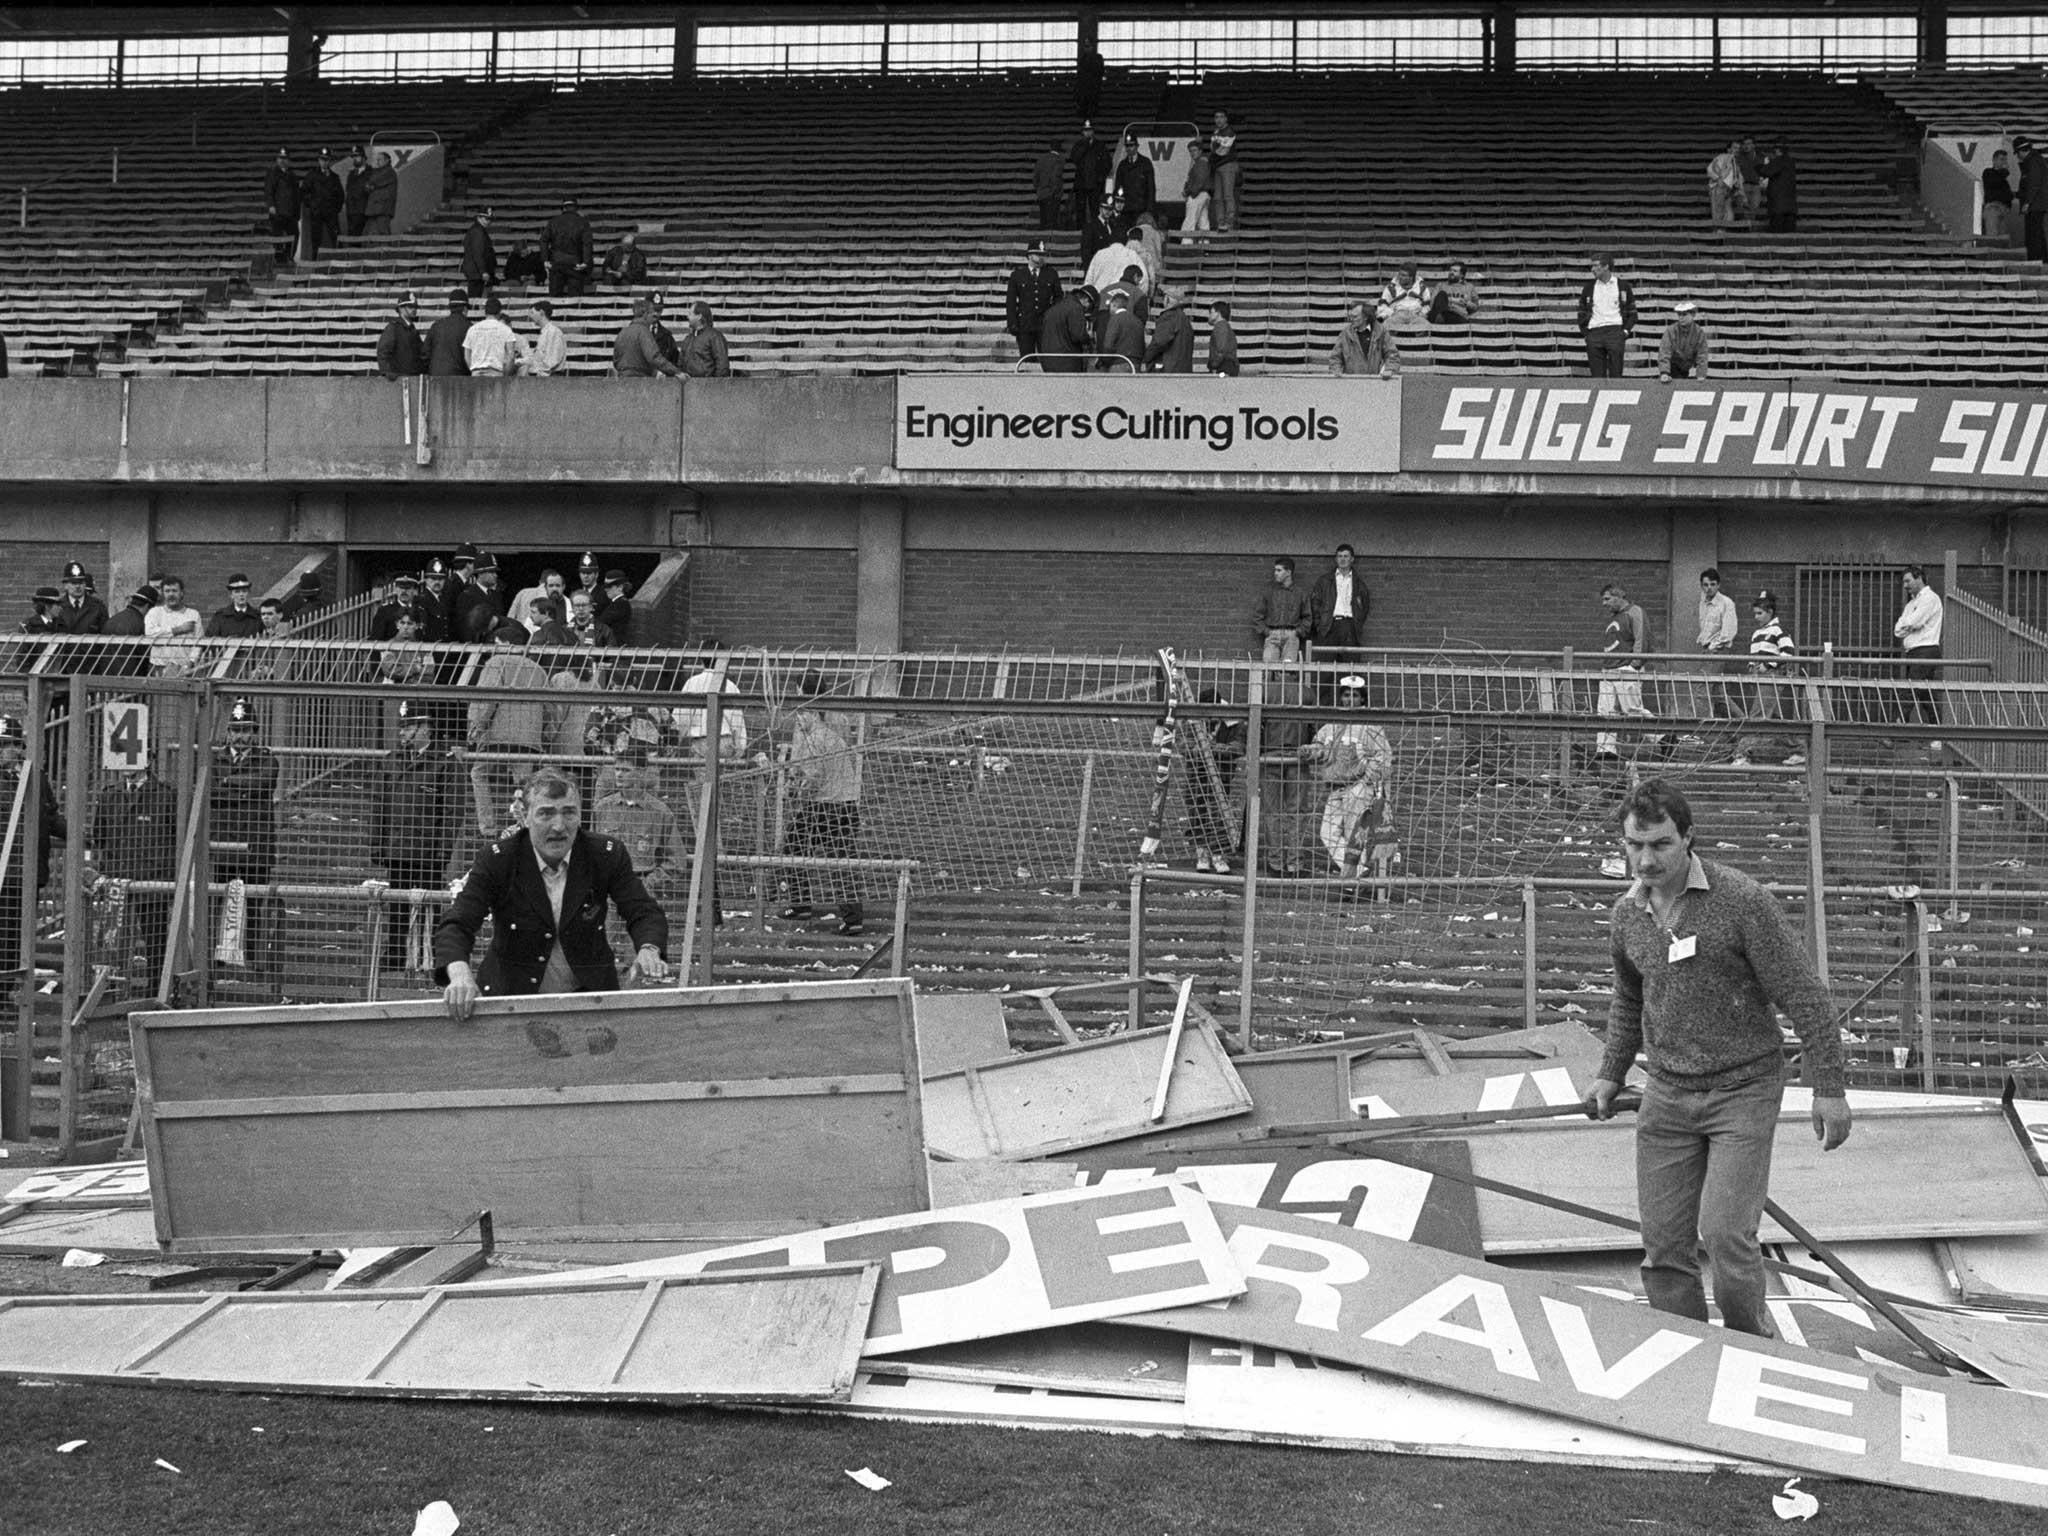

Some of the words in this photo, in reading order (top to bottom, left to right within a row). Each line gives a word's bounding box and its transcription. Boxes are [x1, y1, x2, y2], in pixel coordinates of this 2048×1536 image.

[1148, 141, 1175, 161] W
[1957, 142, 1978, 163] V
[906, 405, 1092, 447] Engineers
[1096, 405, 1233, 450] Cutting
[1239, 407, 1338, 440] Tools
[1432, 388, 1641, 461] SUGG
[1654, 391, 1918, 469] SPORT
[1930, 400, 2048, 478] SU
[110, 708, 142, 765] 4
